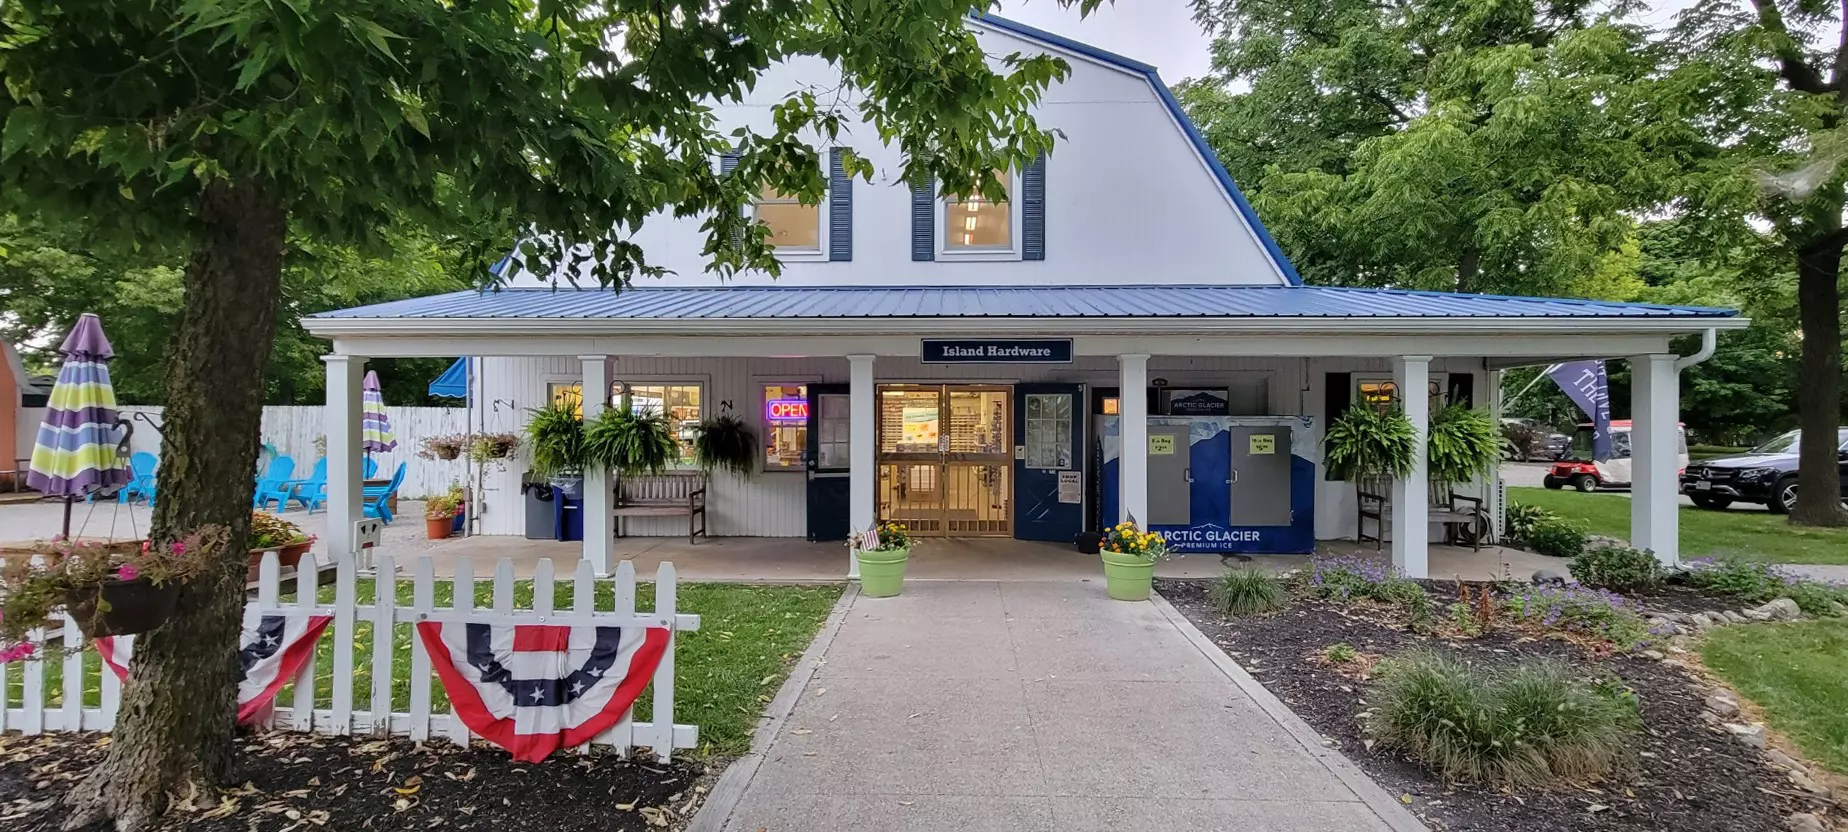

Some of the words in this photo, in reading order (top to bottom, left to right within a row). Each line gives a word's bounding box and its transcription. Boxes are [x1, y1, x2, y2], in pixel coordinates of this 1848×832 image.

[942, 346, 984, 357] Island
[987, 346, 1051, 357] Hardware
[771, 403, 808, 417] OPEN
[1205, 530, 1260, 541] GLACIER
